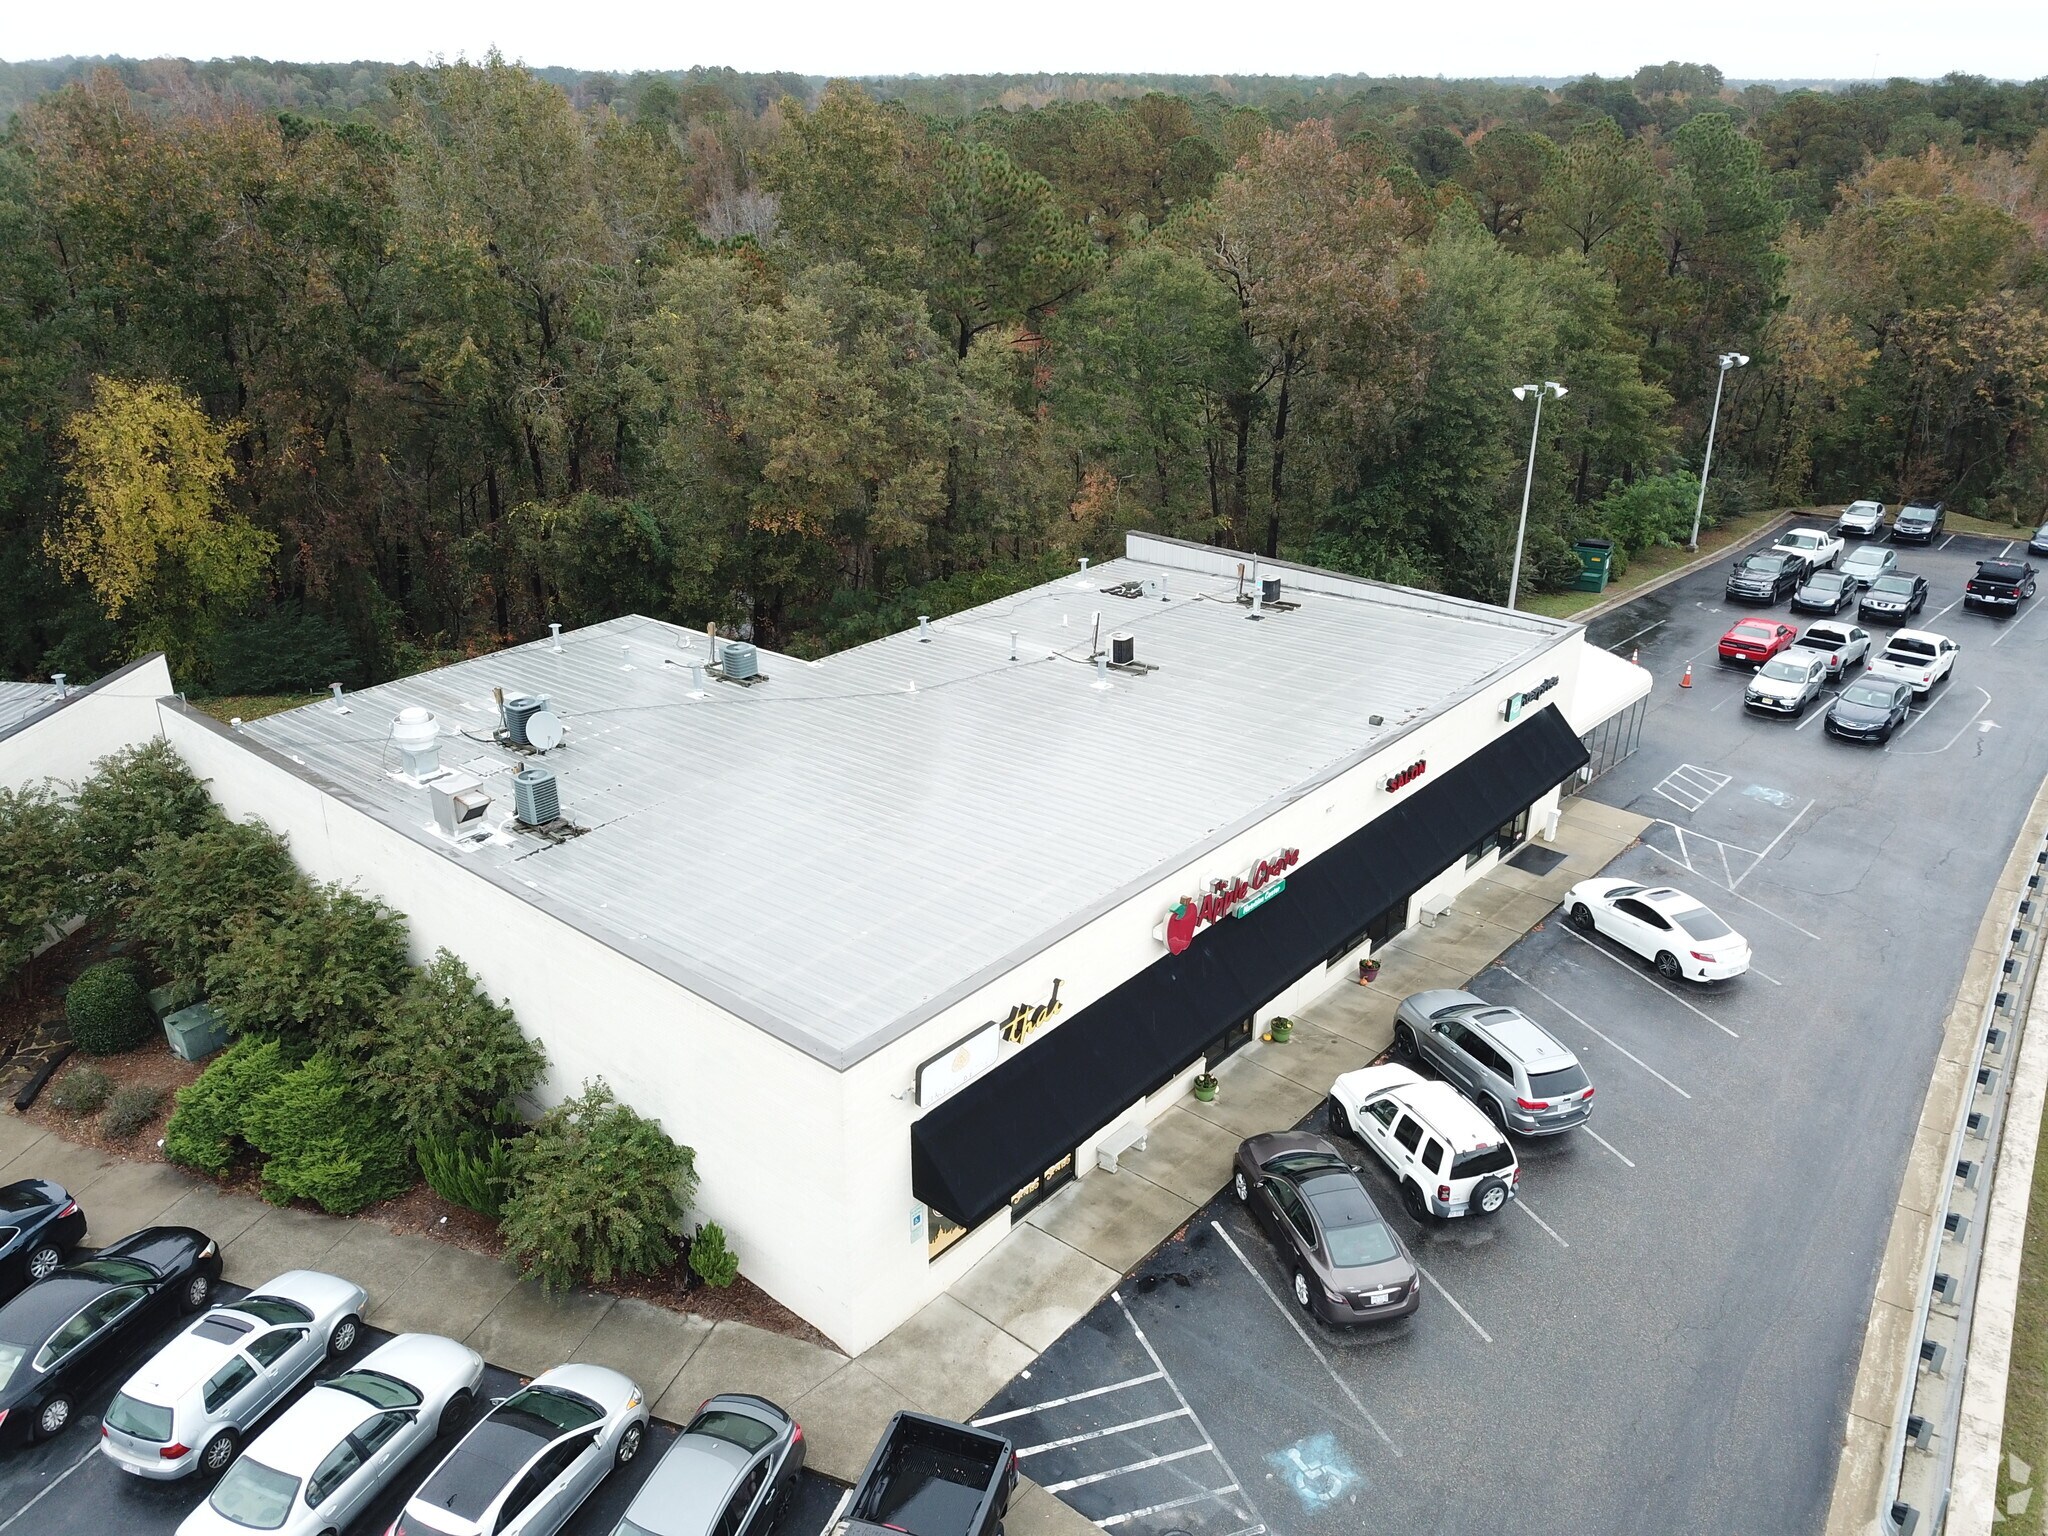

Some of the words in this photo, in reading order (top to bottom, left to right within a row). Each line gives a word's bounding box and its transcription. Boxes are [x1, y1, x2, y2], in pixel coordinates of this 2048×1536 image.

[1386, 759, 1426, 793] SALON
[1196, 877, 1249, 927] Apple
[1251, 848, 1300, 890] Crate
